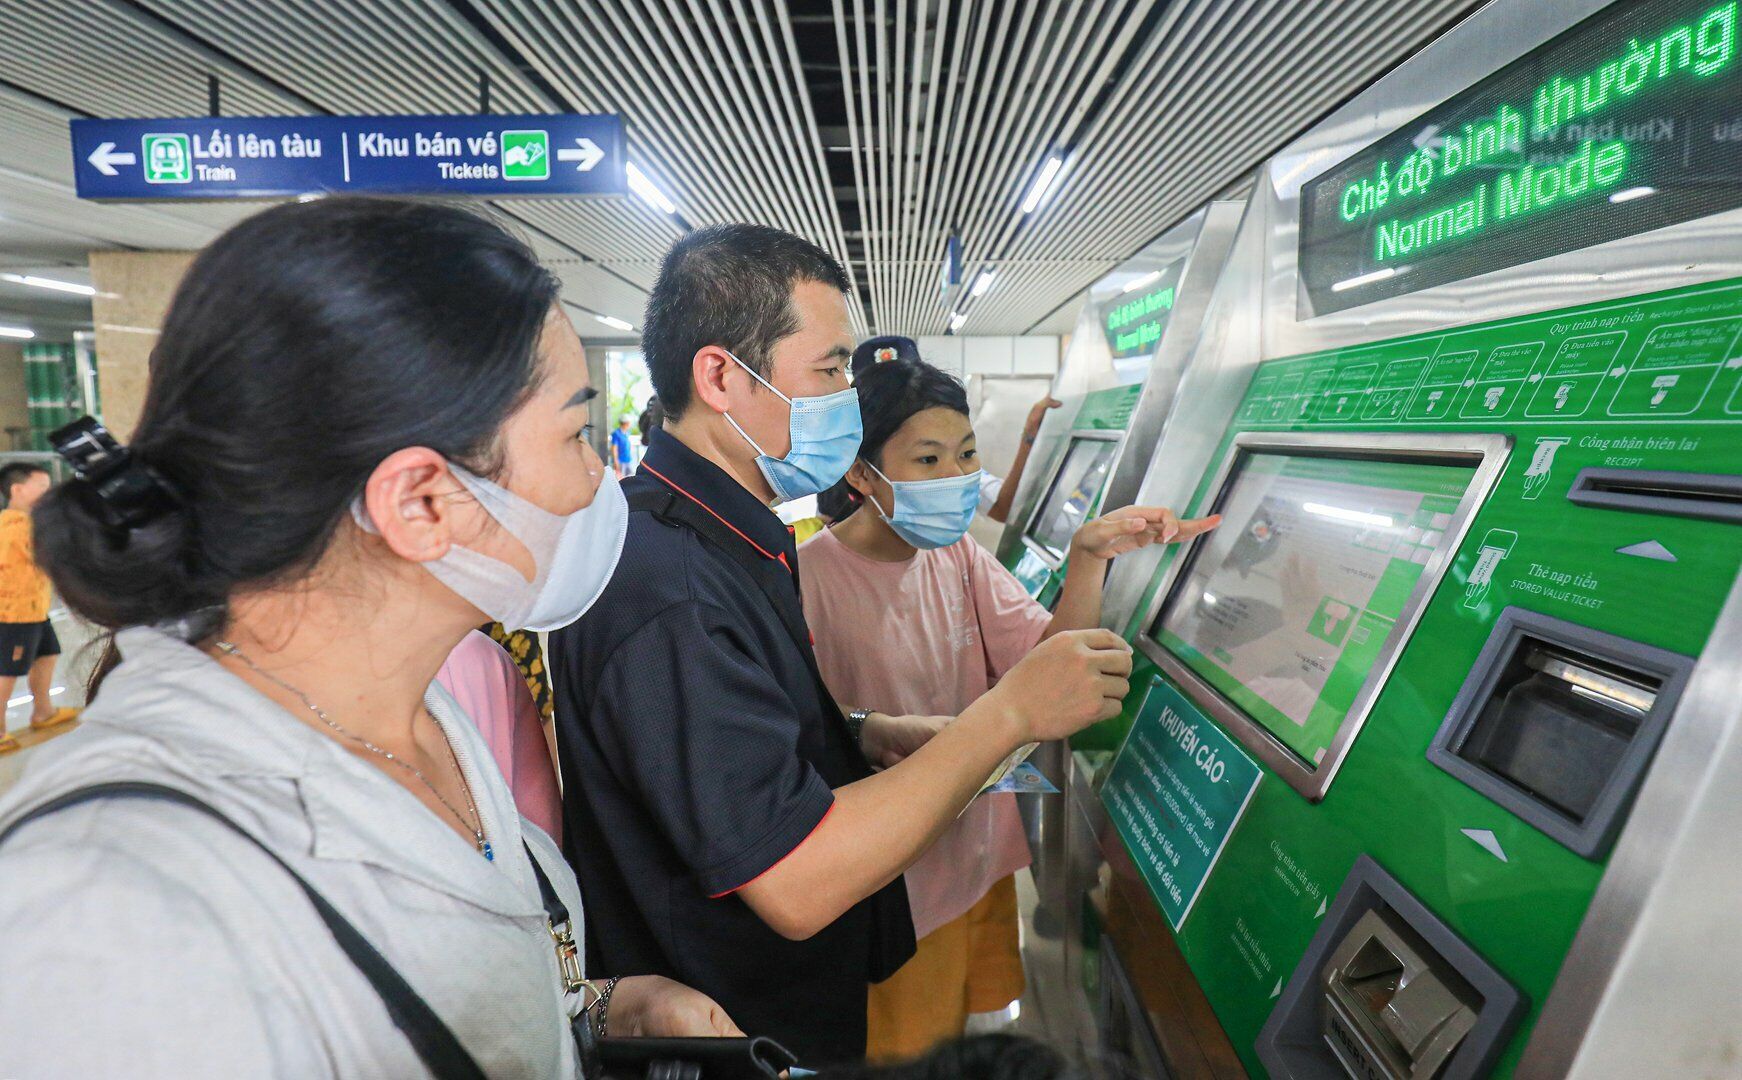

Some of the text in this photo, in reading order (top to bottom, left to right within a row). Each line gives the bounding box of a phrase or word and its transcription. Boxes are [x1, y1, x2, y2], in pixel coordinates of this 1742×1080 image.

[1342, 161, 1389, 221] Chế
[1397, 147, 1435, 195] độ
[1536, 1, 1737, 135] thường
[193, 128, 321, 159] Lối lên tàu
[358, 131, 497, 157] Khu bán vé
[195, 164, 237, 181] Train
[438, 162, 499, 179] Tickets
[1377, 140, 1627, 261] Normal Mode
[1550, 323, 1572, 336] Quy
[1598, 317, 1620, 328] nạp
[1561, 343, 1570, 354] 3
[1611, 436, 1643, 451] nhận
[1645, 436, 1676, 450] biên
[1678, 437, 1701, 451] lai
[1604, 456, 1644, 467] RECEIPT
[1528, 563, 1598, 590] Thẻ nạp tiền
[1511, 579, 1605, 609] STORED VALUE TICKET
[1158, 705, 1200, 757] KHUYẾN
[1195, 744, 1225, 783] CÁO
[1331, 1017, 1365, 1070] INSERT
